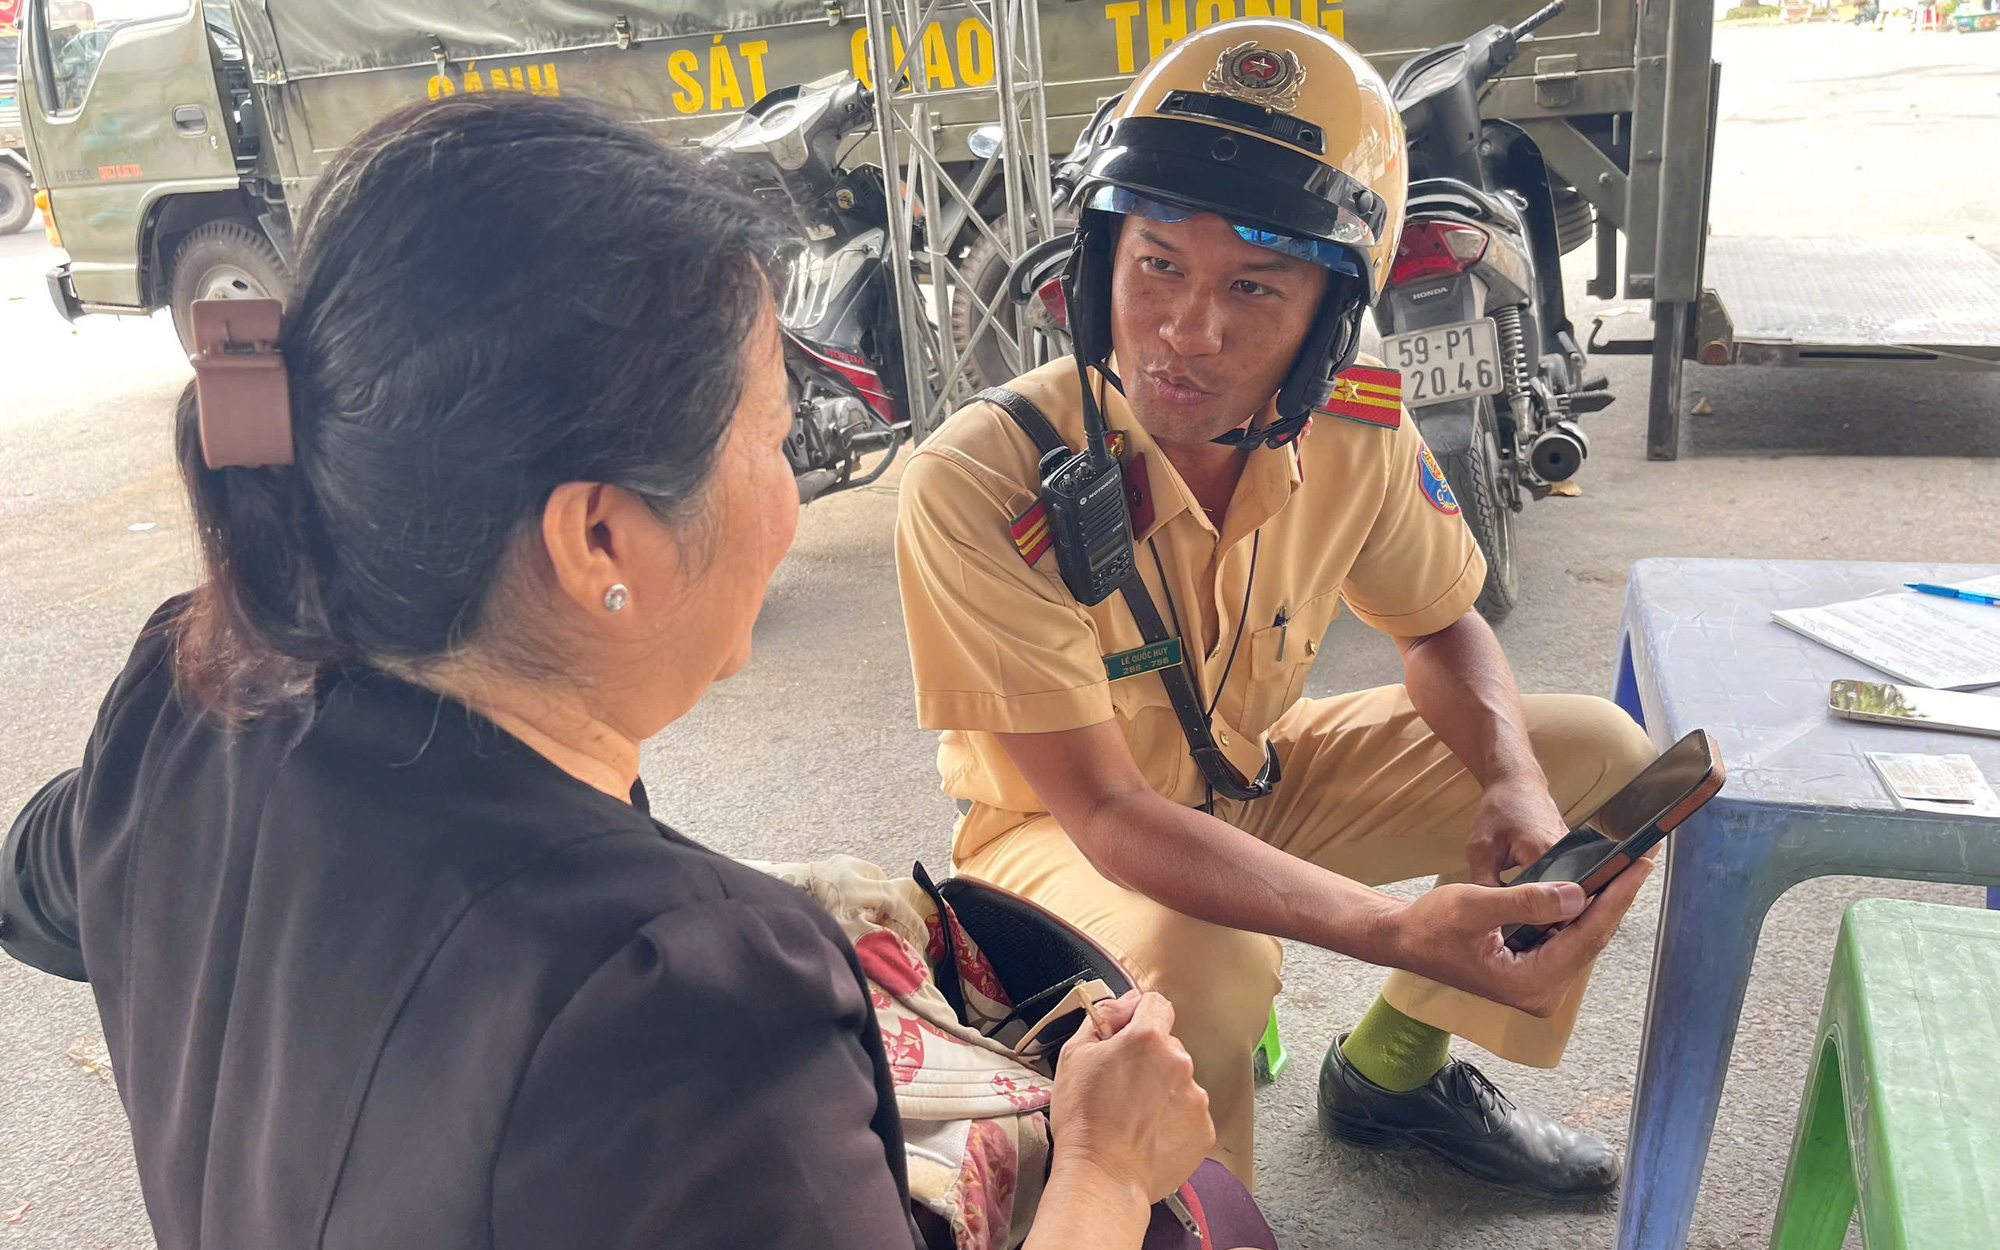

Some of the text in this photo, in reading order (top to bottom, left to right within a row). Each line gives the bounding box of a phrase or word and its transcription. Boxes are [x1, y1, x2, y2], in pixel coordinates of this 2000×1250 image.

[667, 34, 769, 114] SÁT
[1412, 287, 1448, 300] HONDA
[825, 348, 866, 366] HONDA
[1411, 359, 1493, 400] 20.46
[1153, 647, 1168, 658] HUY
